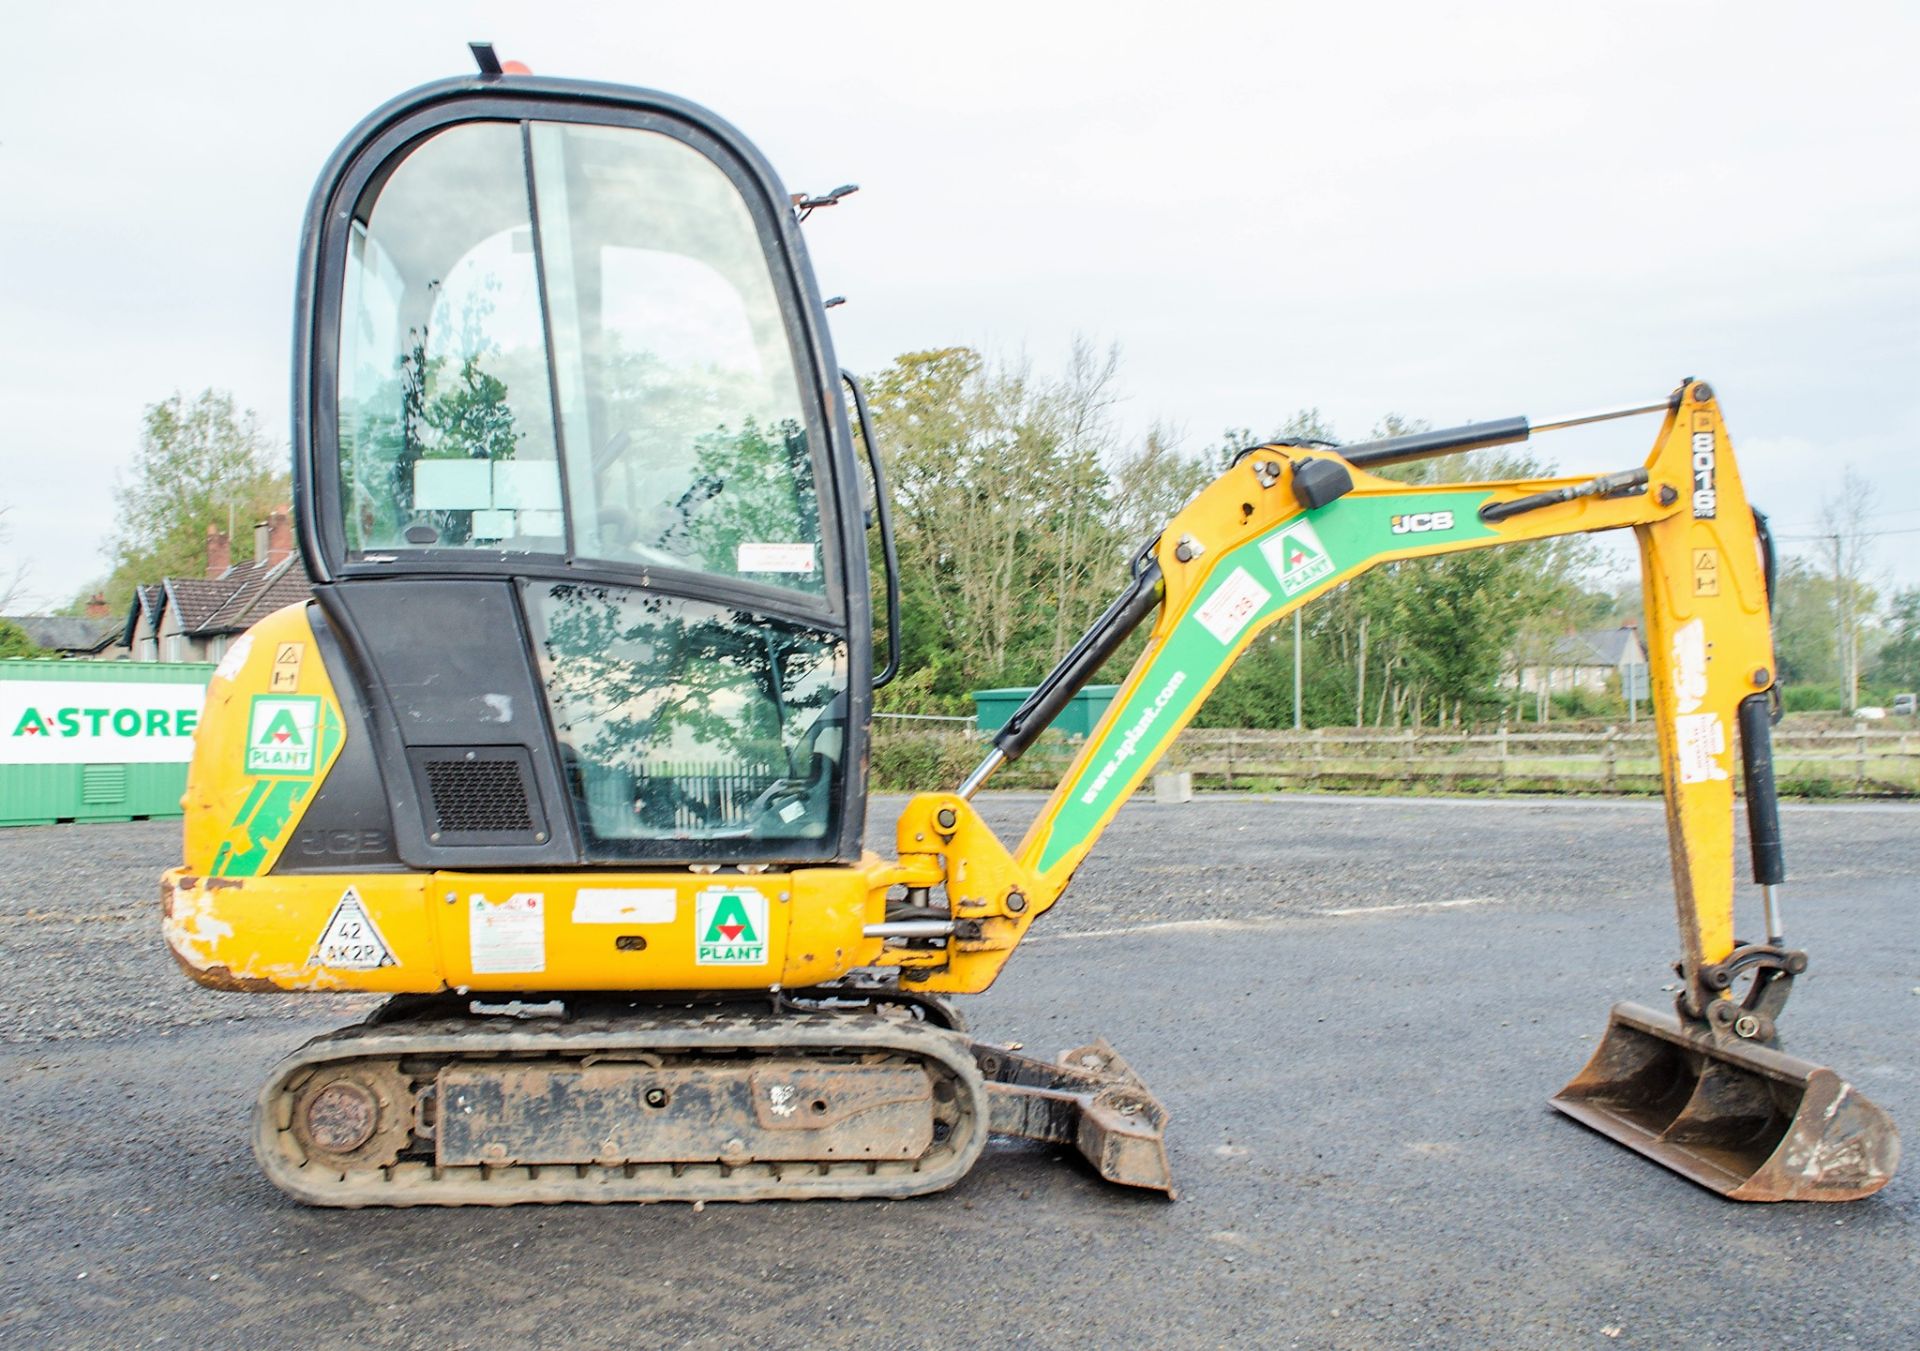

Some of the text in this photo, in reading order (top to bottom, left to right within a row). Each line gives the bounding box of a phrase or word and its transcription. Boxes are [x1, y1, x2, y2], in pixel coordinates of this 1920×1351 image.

[1693, 432, 1716, 509] 8016
[1391, 510, 1455, 535] JCB
[1283, 535, 1319, 574] A
[1283, 558, 1328, 591] PLANT
[259, 709, 305, 745] A
[1082, 670, 1187, 804] www.aplant.com
[252, 751, 308, 764] PLANT
[301, 828, 388, 855] JCB
[339, 922, 361, 939] 42
[704, 895, 758, 942] A
[700, 946, 763, 960] PLANT
